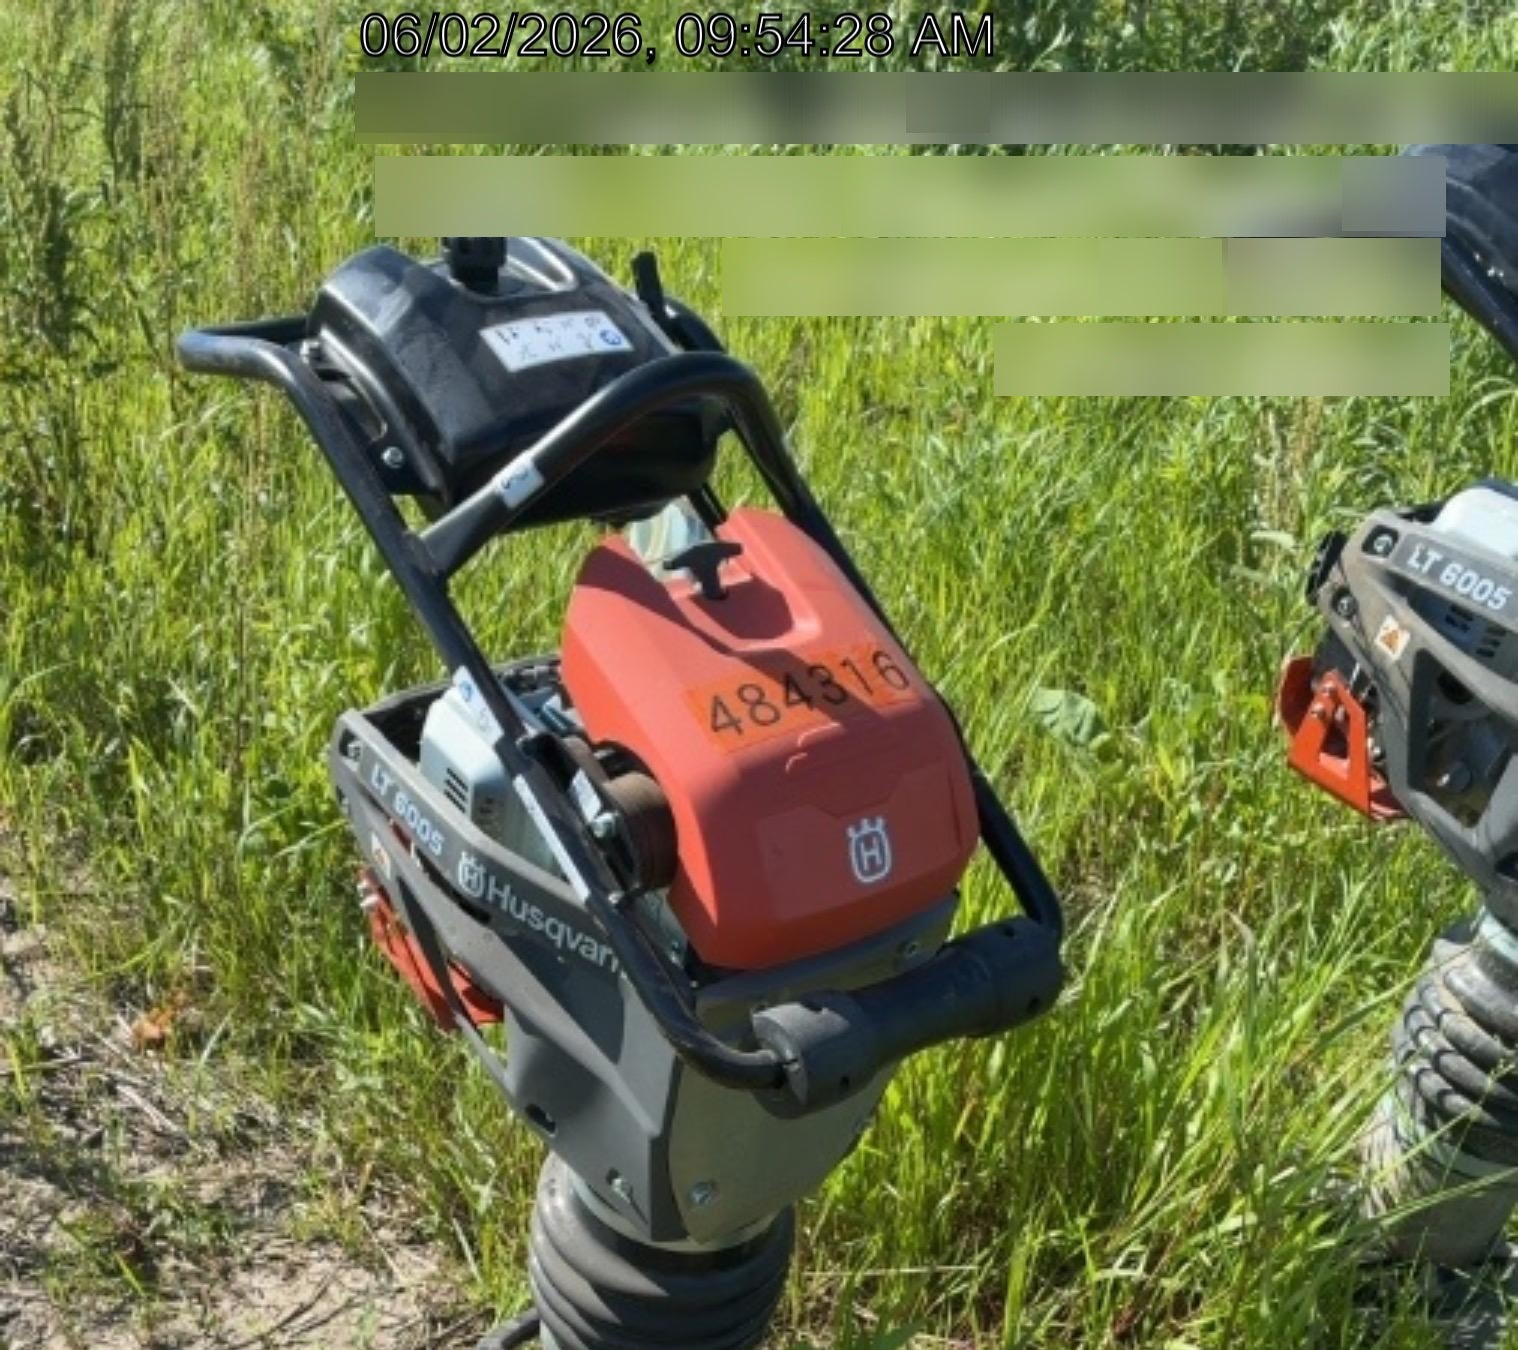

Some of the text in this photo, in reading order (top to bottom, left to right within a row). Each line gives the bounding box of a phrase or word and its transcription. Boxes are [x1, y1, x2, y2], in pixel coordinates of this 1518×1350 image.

[1407, 543, 1513, 610] LT 6005
[710, 650, 910, 736] 484316
[371, 763, 444, 856] LT 6005
